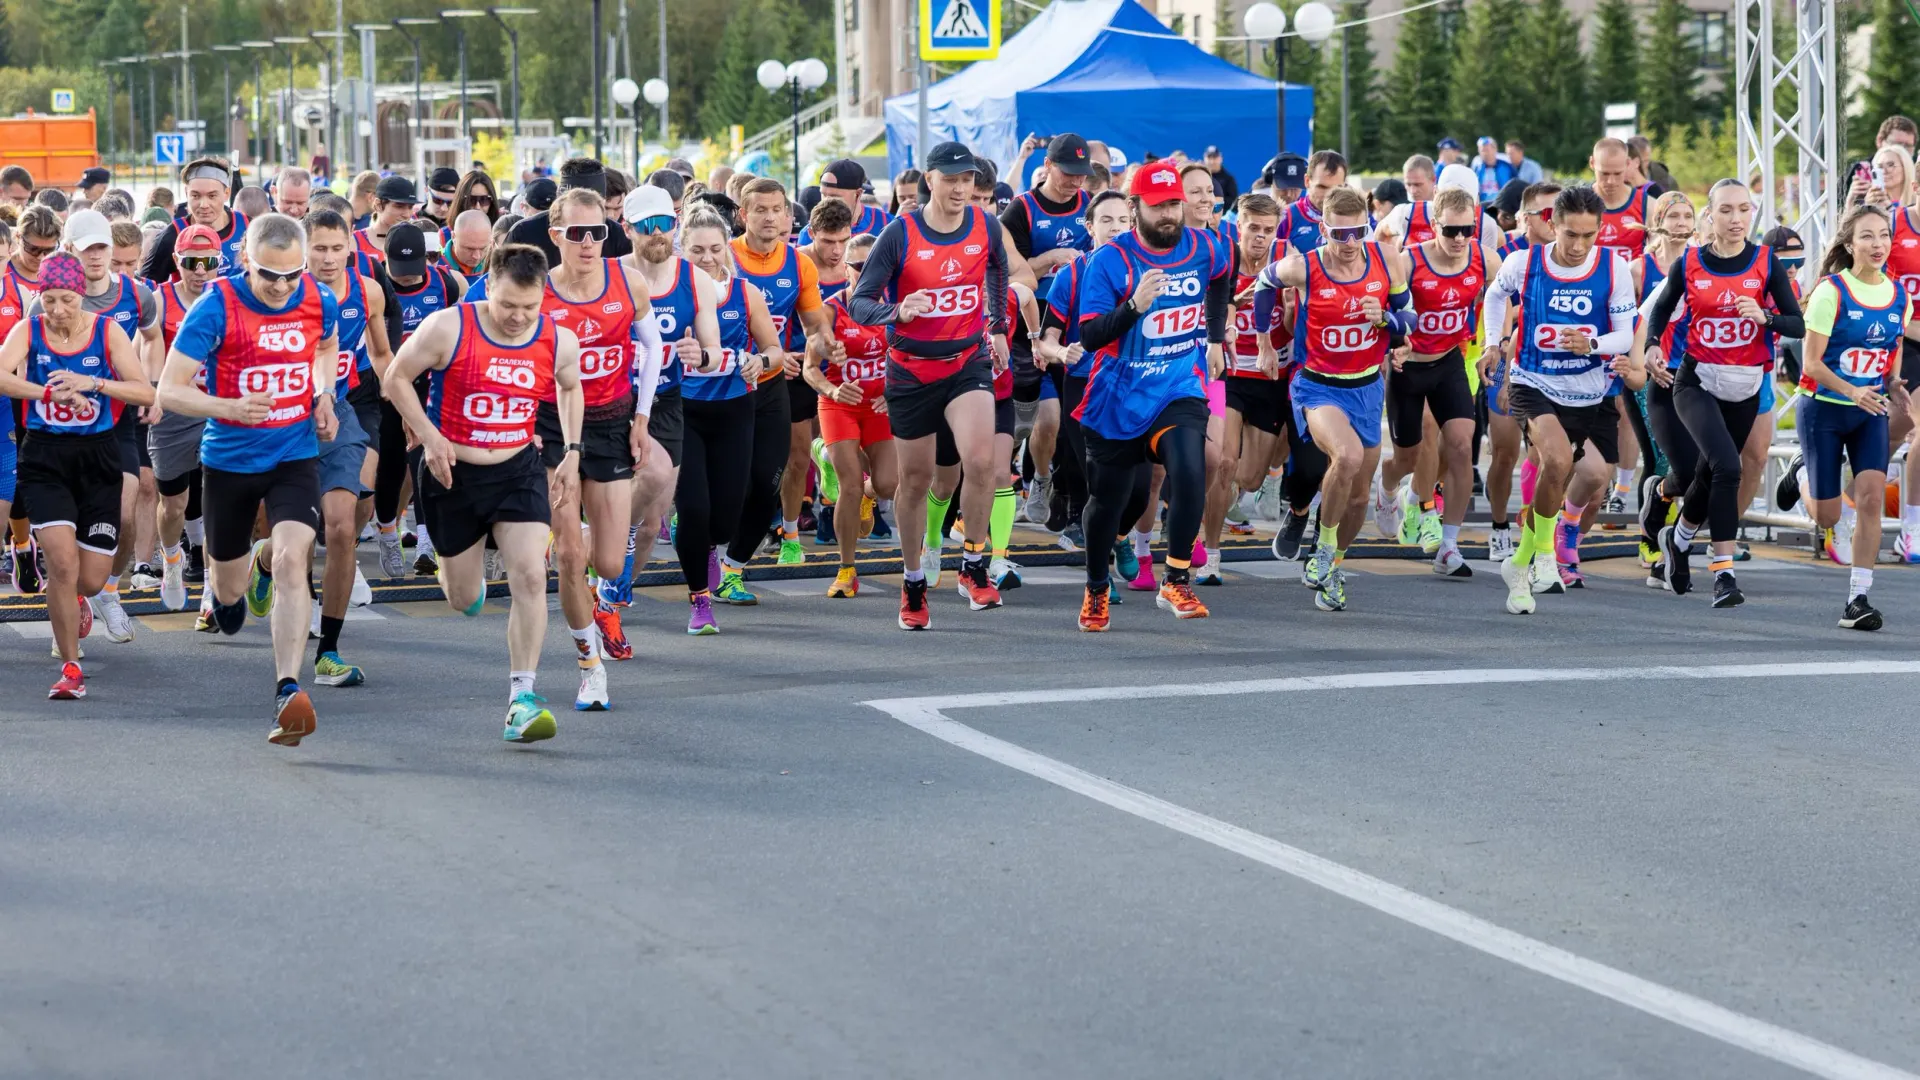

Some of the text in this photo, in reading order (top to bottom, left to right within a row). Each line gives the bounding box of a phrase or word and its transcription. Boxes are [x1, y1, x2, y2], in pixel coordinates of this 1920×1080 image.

[1560, 289, 1592, 297] САЛЕХАРД
[1548, 296, 1593, 316] 430
[267, 321, 304, 332] САЛЕХАРД
[1152, 306, 1197, 335] 112
[1424, 311, 1467, 332] 001
[1699, 319, 1755, 344] 030
[258, 329, 306, 353] 430
[1323, 326, 1378, 350] 004
[498, 358, 535, 369] САЛЕХАРД
[1847, 350, 1887, 374] 175
[246, 366, 306, 394] 015
[485, 364, 536, 390] 430
[469, 395, 534, 419] 014
[88, 522, 117, 540] LOS ANGELES
